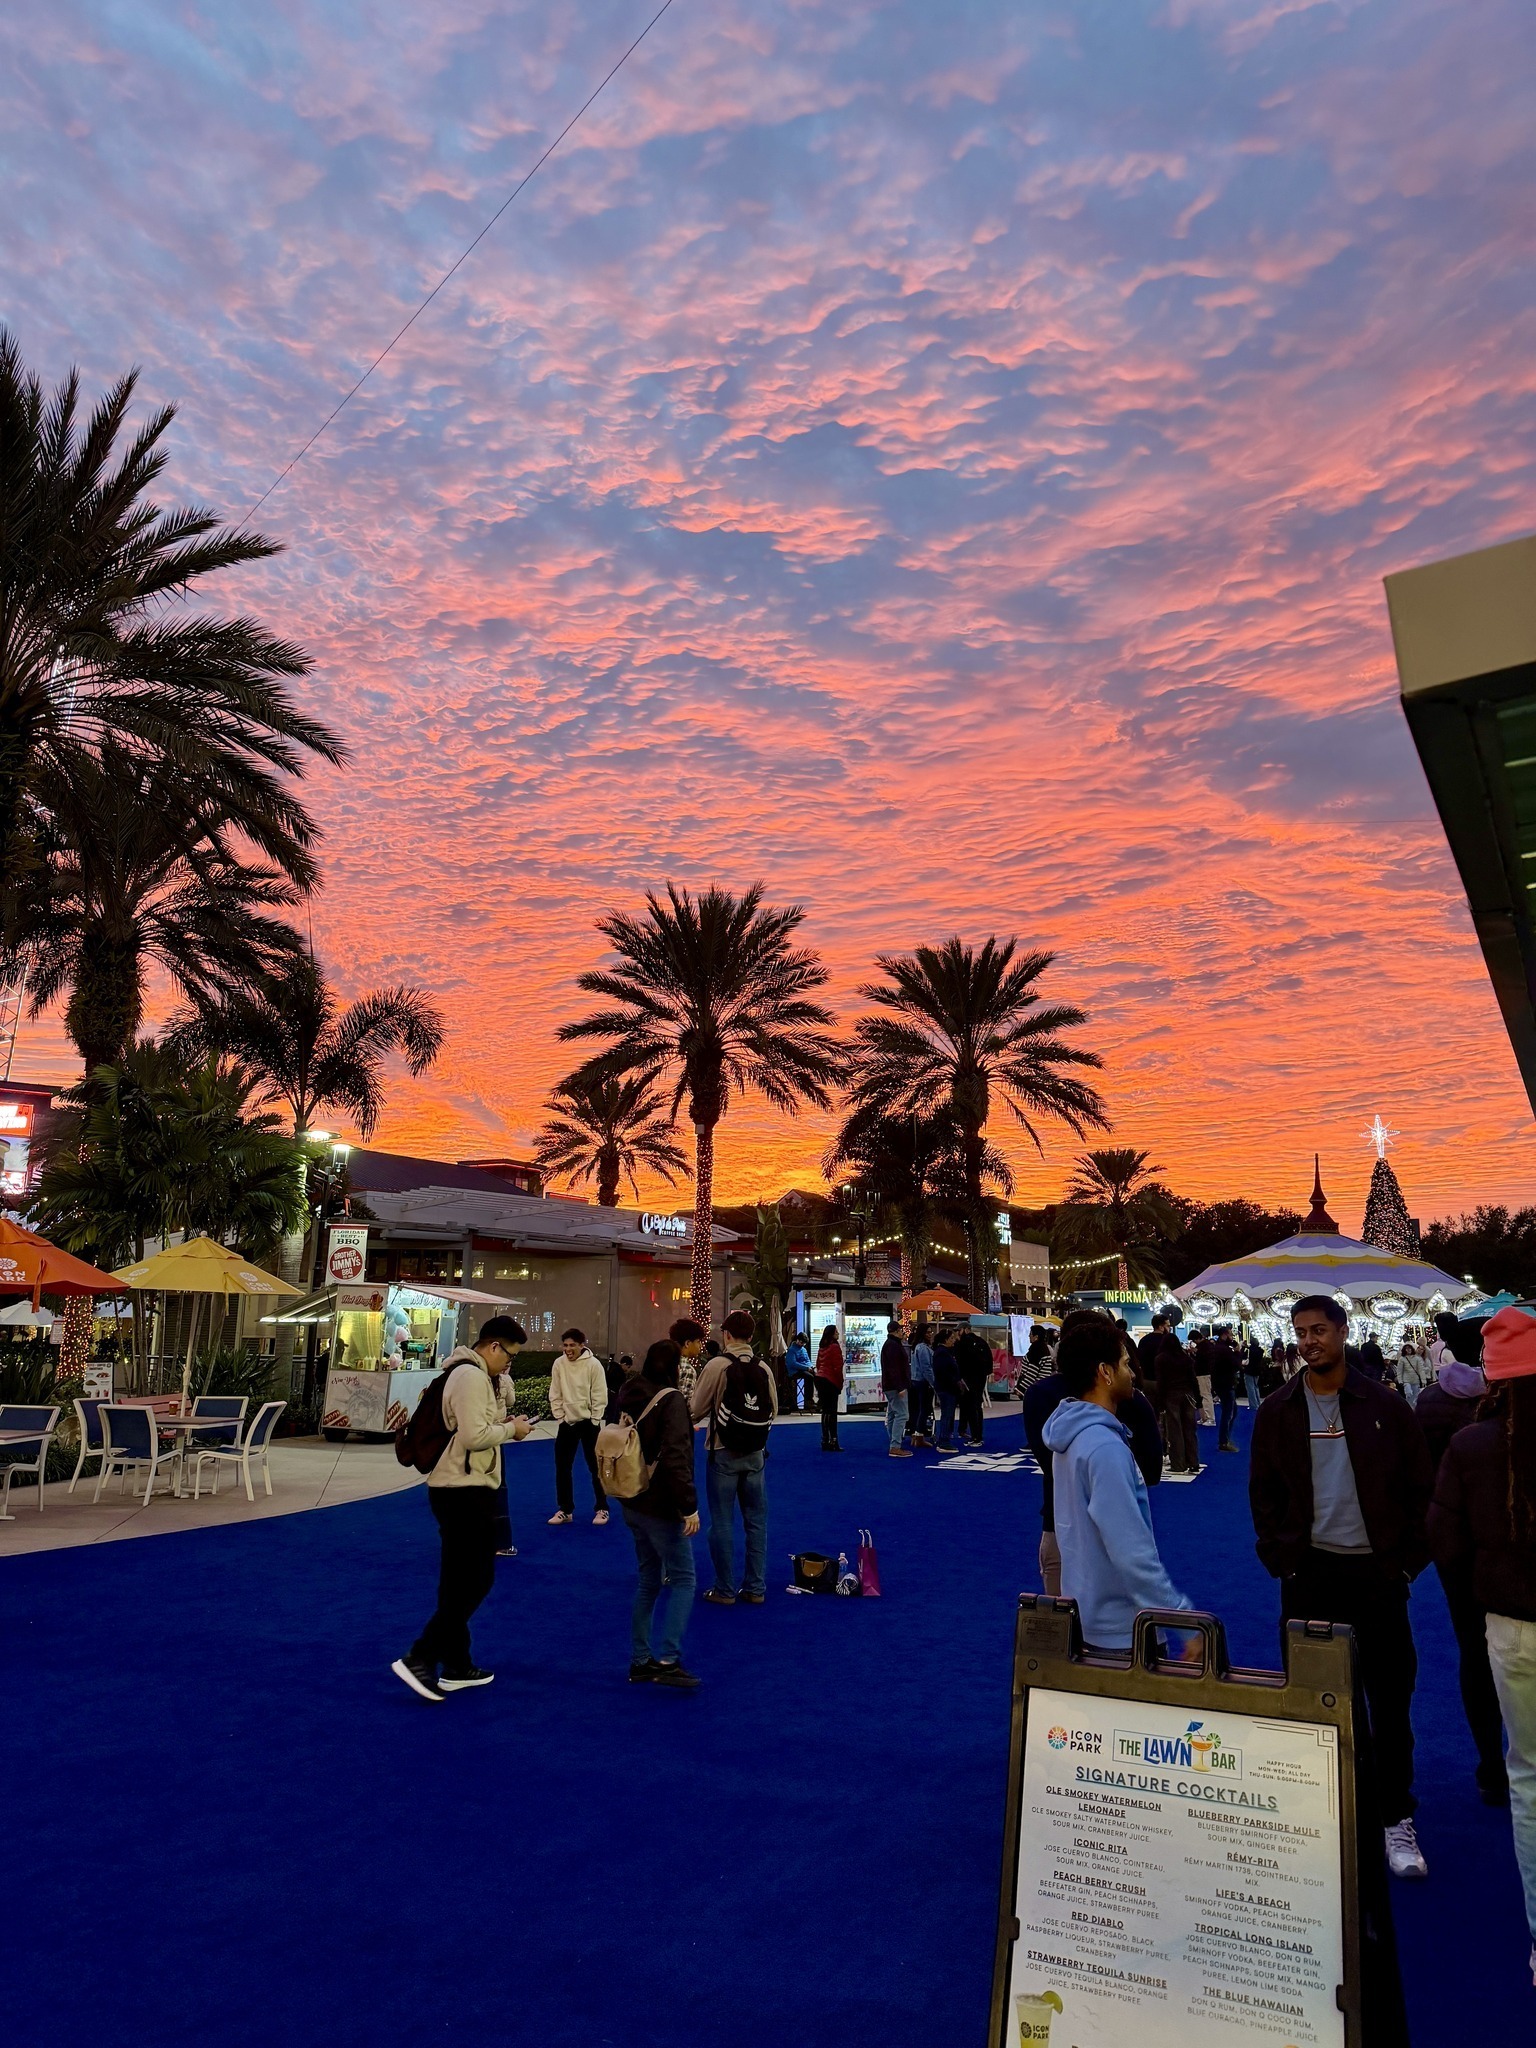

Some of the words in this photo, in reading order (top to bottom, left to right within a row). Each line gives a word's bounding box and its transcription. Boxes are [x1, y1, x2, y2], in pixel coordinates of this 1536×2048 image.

[334, 1250, 356, 1260] BROTHER
[1105, 1291, 1162, 1303] INFORMAT
[1070, 1741, 1101, 1754] PARK
[1071, 1730, 1102, 1743] ICON
[1119, 1739, 1141, 1757] THE
[1144, 1737, 1192, 1766] LAWN
[1211, 1752, 1236, 1770] BAR
[1046, 1786, 1061, 1795] OLE
[1064, 1789, 1099, 1801] SMOKEY
[1101, 1794, 1162, 1811] WATERMELON
[1076, 1766, 1170, 1792] SIGNATURE
[1177, 1782, 1278, 1809] COCKTAILS
[1046, 1809, 1072, 1819] SMOKEY
[1074, 1814, 1092, 1822] SALTY
[1094, 1818, 1140, 1830] WATERMELON
[1142, 1825, 1174, 1837] WHISKEY,
[1078, 1803, 1126, 1818] LEMONADE
[1188, 1808, 1241, 1824] BLUEBERRY
[1244, 1818, 1290, 1832] PARKSIDE
[1293, 1826, 1320, 1837] MULE
[1052, 1820, 1070, 1828] SOUR
[1072, 1823, 1086, 1832] MIX,
[1088, 1826, 1128, 1838] CRANBERRY
[1198, 1822, 1238, 1834] BLUEBERRY
[1240, 1828, 1278, 1840] SMIRNOFF
[1280, 1836, 1308, 1846] VODKA,
[1074, 1838, 1105, 1850] ICONIC
[1108, 1844, 1128, 1855] RITA
[1208, 1834, 1226, 1842] SOUR
[1230, 1838, 1245, 1846] MIX,
[1247, 1841, 1276, 1851] GINGER
[1044, 1844, 1060, 1852] JOSE
[1062, 1848, 1090, 1858] CUERVO
[1092, 1852, 1121, 1865] BLANCO,
[1123, 1859, 1166, 1873] COINTREAU,
[1056, 1856, 1075, 1864] SOUR
[1076, 1860, 1090, 1869] MIX,
[1092, 1863, 1120, 1874] ORANGE
[1227, 1852, 1279, 1869] RÉMY-RITA
[1054, 1870, 1081, 1882] PEACH
[1085, 1876, 1113, 1888] BERRY
[1115, 1883, 1146, 1896] CRUSH
[1184, 1857, 1203, 1866] RÉMY
[1206, 1860, 1233, 1871] MARTIN
[1256, 1870, 1301, 1884] COINTREAU,
[1304, 1878, 1325, 1888] SOUR
[1038, 1890, 1065, 1900] ORANGE
[1091, 1900, 1135, 1914] STRAWBERRY
[1040, 1880, 1076, 1892] BEEFEATER
[1078, 1888, 1092, 1896] GIN,
[1094, 1890, 1117, 1900] PEACH
[1119, 1896, 1158, 1909] SCHNAPPS,
[1216, 1888, 1244, 1900] LIFE'S
[1248, 1895, 1254, 1903] A
[1258, 1896, 1291, 1910] BEACH
[1071, 1911, 1088, 1922] RED
[1092, 1916, 1124, 1930] DIABLO
[1184, 1895, 1222, 1907] SMIRNOFF
[1224, 1902, 1251, 1914] VODKA,
[1253, 1908, 1278, 1919] PEACH
[1281, 1914, 1324, 1928] SCHNAPPS,
[1201, 1909, 1232, 1920] ORANGE
[1026, 1924, 1063, 1937] RASPBERRY
[1065, 1933, 1096, 1945] LIQUEUR,
[1099, 1940, 1144, 1955] STRAWBERRY
[1146, 1950, 1171, 1961] PUREE,
[1042, 1918, 1058, 1926] JOSE
[1061, 1922, 1088, 1932] CUERVO
[1091, 1928, 1129, 1942] REPOSADO,
[1132, 1936, 1154, 1946] BLACK
[1195, 1923, 1242, 1940] TROPICAL
[1246, 1933, 1273, 1946] LONG
[1276, 1939, 1313, 1955] ISLAND
[1076, 1946, 1116, 1960] CRANBERRY
[1186, 1934, 1204, 1943] JOSE
[1207, 1938, 1238, 1950] CUERVO
[1240, 1945, 1273, 1958] BLANCO,
[1276, 1952, 1293, 1961] DON
[1295, 1955, 1300, 1963] Q
[1304, 1958, 1323, 1969] RUM,
[1188, 1945, 1226, 1958] SMIRNOFF
[1228, 1954, 1255, 1965] VODKA,
[1258, 1960, 1301, 1974] BEEFEATER
[1303, 1968, 1320, 1979] GIN,
[1026, 1962, 1042, 1971] JOSE
[1044, 1966, 1072, 1978] CUERVO
[1074, 1973, 1103, 1985] TEQUILA
[1105, 1980, 1136, 1993] BLANCO,
[1138, 1988, 1168, 2000] ORANGE
[1028, 1950, 1084, 1970] STRAWBERRY
[1087, 1963, 1124, 1979] TEQUILA
[1128, 1972, 1167, 1988] SUNRISE
[1182, 1955, 1208, 1966] PEACH
[1210, 1960, 1252, 1976] SCHNAPPS,
[1254, 1968, 1275, 1979] SOUR
[1296, 1978, 1326, 1991] MANGO
[1202, 1970, 1229, 1982] PUREE,
[1231, 1976, 1258, 1987] LEMON
[1261, 1983, 1278, 1992] LIME
[1048, 1978, 1069, 1989] JUICE,
[1072, 1983, 1116, 1998] STRAWBERRY
[1203, 1986, 1221, 1998] THE
[1226, 1990, 1249, 2004] BLUE
[1254, 1997, 1304, 2016] HAWAIIAN
[1187, 2007, 1206, 2017] BLUE
[1250, 2020, 1292, 2037] PINEAPPLE
[1192, 1997, 1208, 2007] DON
[1219, 2002, 1237, 2013] RUM,
[1240, 2006, 1257, 2016] DON
[1268, 2014, 1292, 2024] COCO
[1293, 2020, 1314, 2030] RUM,
